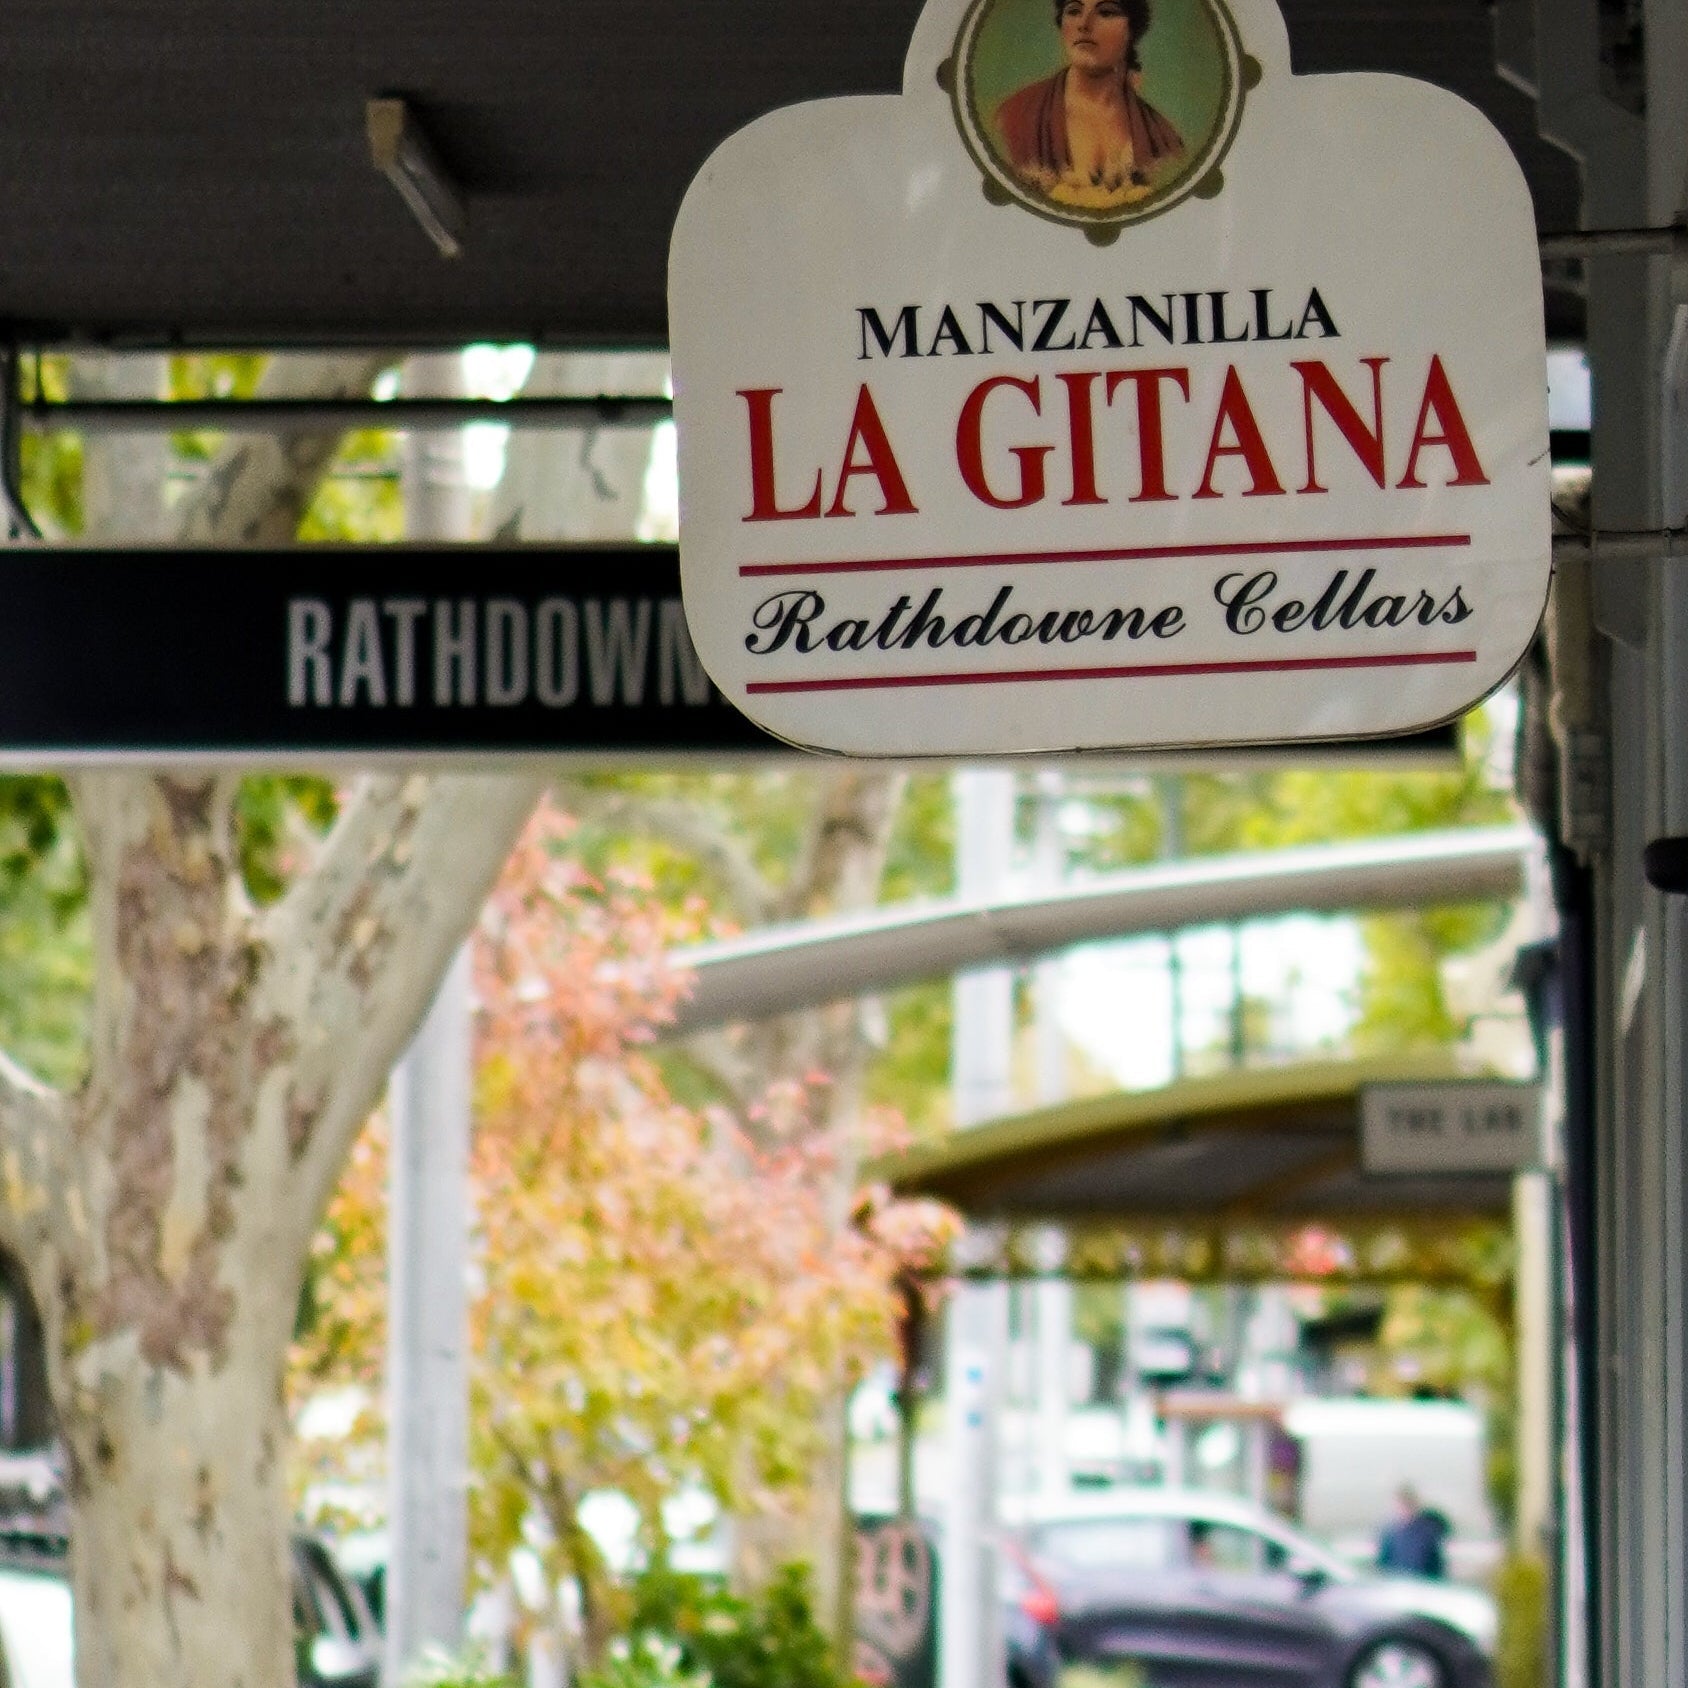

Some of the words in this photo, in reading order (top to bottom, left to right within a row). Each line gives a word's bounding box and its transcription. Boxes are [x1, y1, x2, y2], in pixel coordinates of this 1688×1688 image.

[855, 286, 1341, 361] MANZANILLA
[735, 383, 919, 523] LA
[955, 353, 1491, 511] GITANA
[286, 595, 728, 707] RATHDOWN
[745, 586, 1187, 656] Rathdowne
[1213, 569, 1475, 635] Cellars
